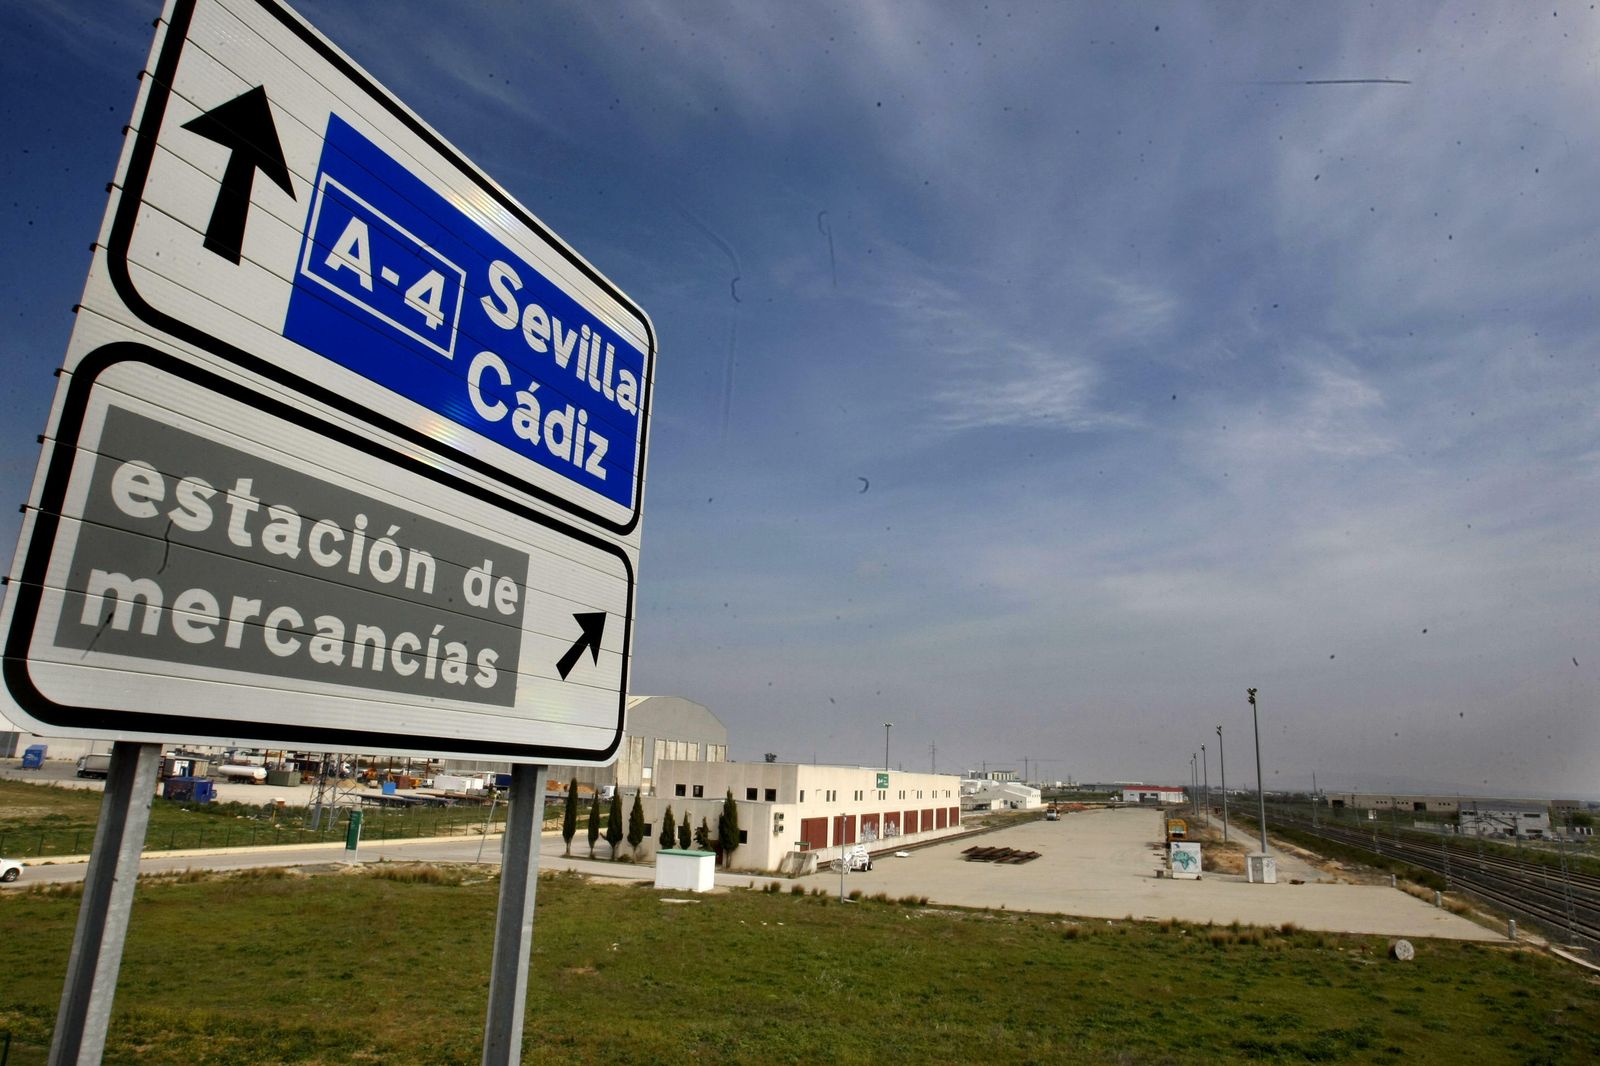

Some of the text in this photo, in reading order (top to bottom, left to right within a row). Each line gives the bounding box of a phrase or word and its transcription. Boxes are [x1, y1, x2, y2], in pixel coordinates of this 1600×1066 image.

[324, 216, 445, 331] A-4
[480, 260, 638, 416] Sevilla
[467, 351, 609, 480] Cádiz
[111, 460, 518, 615] estación de
[80, 568, 500, 689] mercancías
